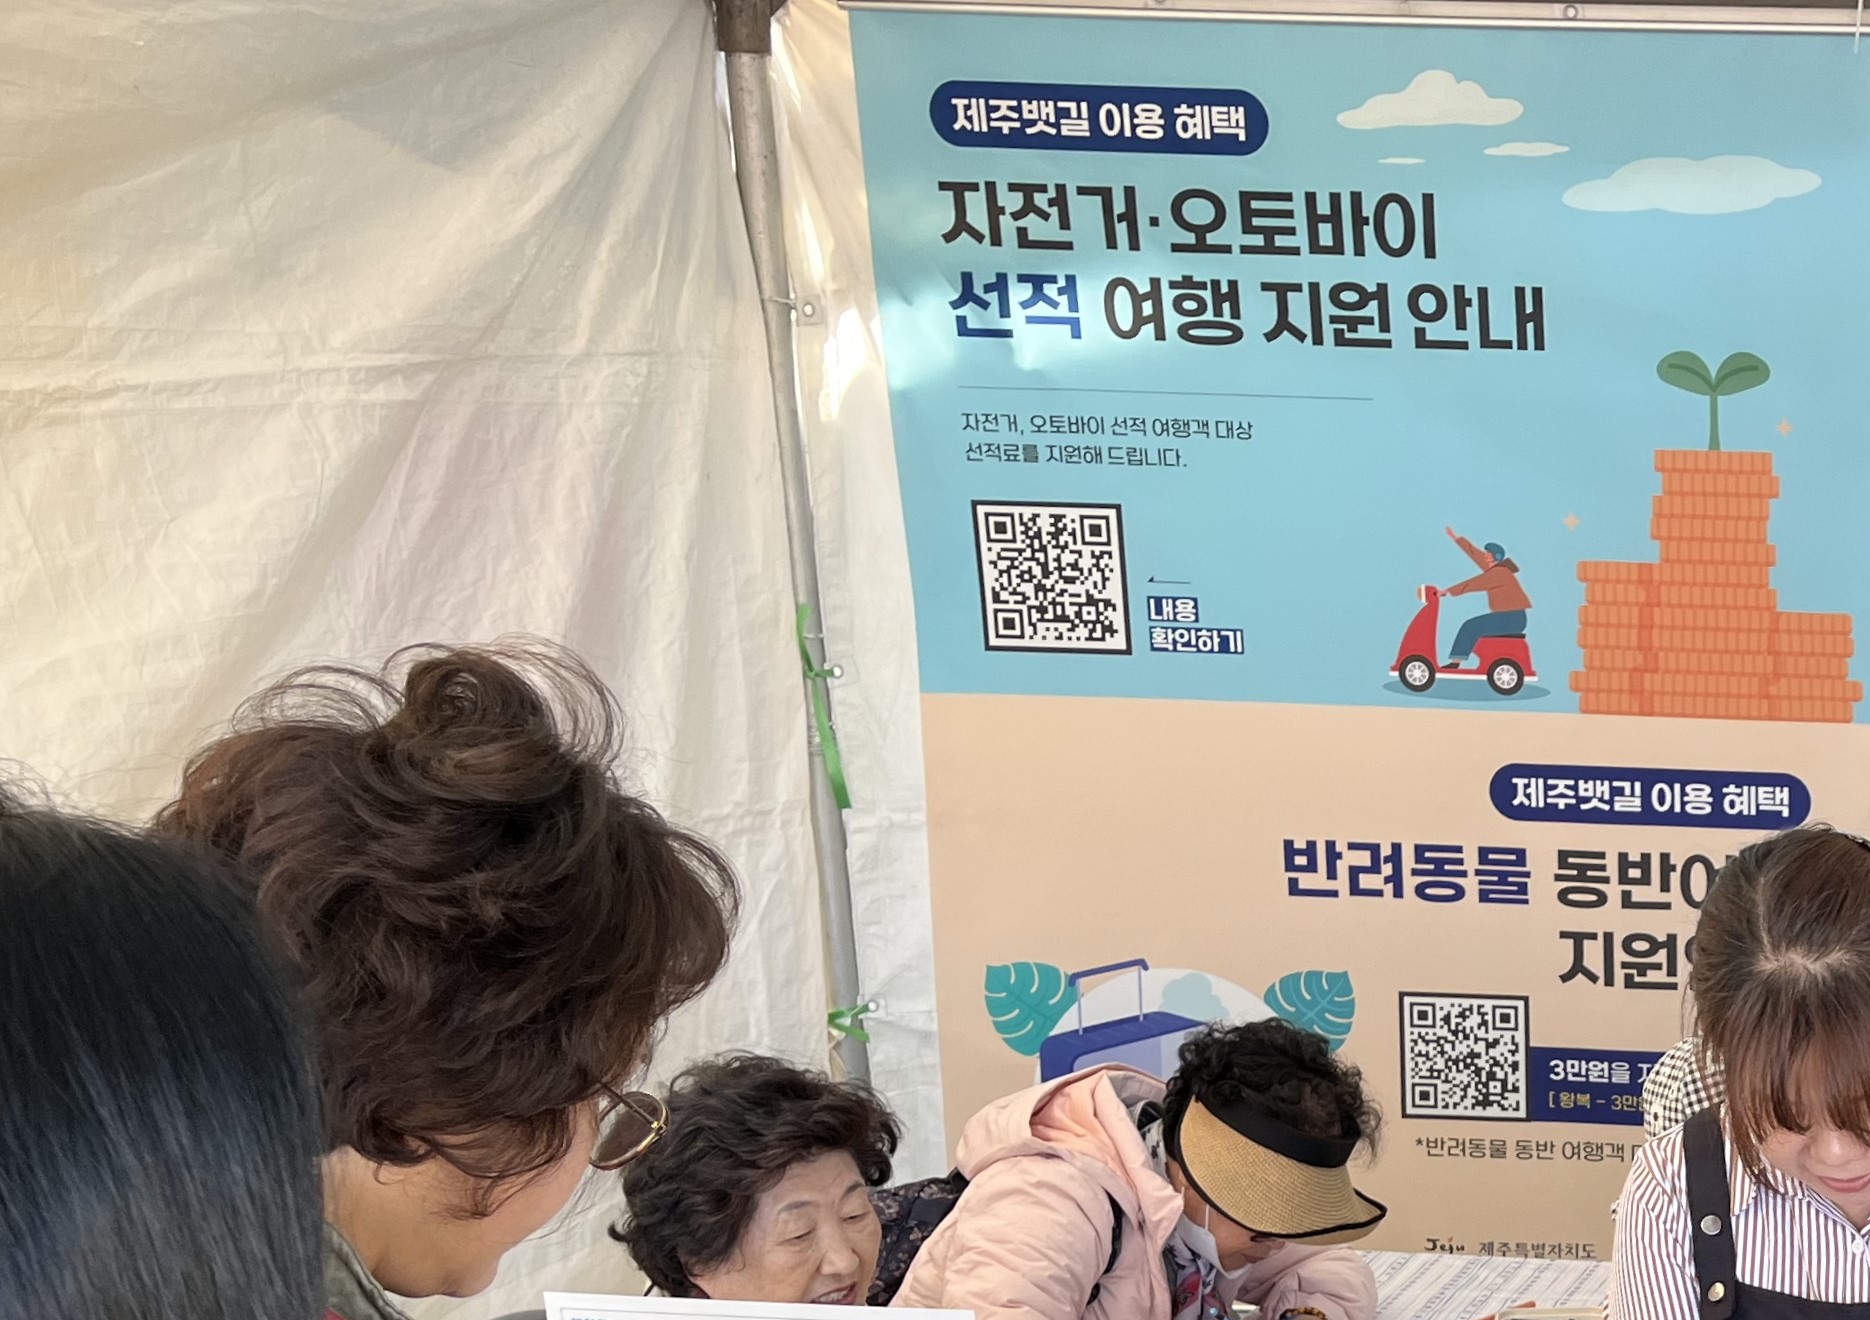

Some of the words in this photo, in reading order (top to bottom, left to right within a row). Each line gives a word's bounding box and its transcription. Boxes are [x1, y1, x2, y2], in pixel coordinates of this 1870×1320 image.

[951, 97, 1090, 137] 제주뱃길
[1099, 102, 1165, 139] 이용
[1173, 104, 1247, 142] 혜택
[948, 272, 1082, 340] 선적
[1104, 275, 1244, 346] 여행
[1261, 281, 1393, 349] 지원
[1407, 284, 1546, 351] 안내
[961, 413, 1024, 435] 자전거,
[1030, 414, 1105, 435] 오토바이
[1110, 416, 1147, 436] 선적
[1152, 417, 1210, 439] 여행객
[1215, 420, 1253, 441] 대상
[965, 442, 1039, 463] 선적료를
[1046, 445, 1103, 465] 지원해
[1108, 447, 1187, 467] 드립니다.
[1149, 598, 1197, 622] 내용
[1151, 628, 1243, 653] 확인하기
[1511, 777, 1642, 813] 제주뱃길
[1652, 781, 1715, 815] 이용
[1722, 783, 1790, 818] 혜택
[1283, 839, 1531, 905] 반려동물
[1559, 930, 1698, 990] 지원
[1549, 1060, 1630, 1083] 3만원을
[1559, 1093, 1590, 1108] 왕복
[1515, 1141, 1555, 1160] 동반
[1562, 1142, 1624, 1162] 여행객
[1478, 1241, 1597, 1259] 제주특별자치도
